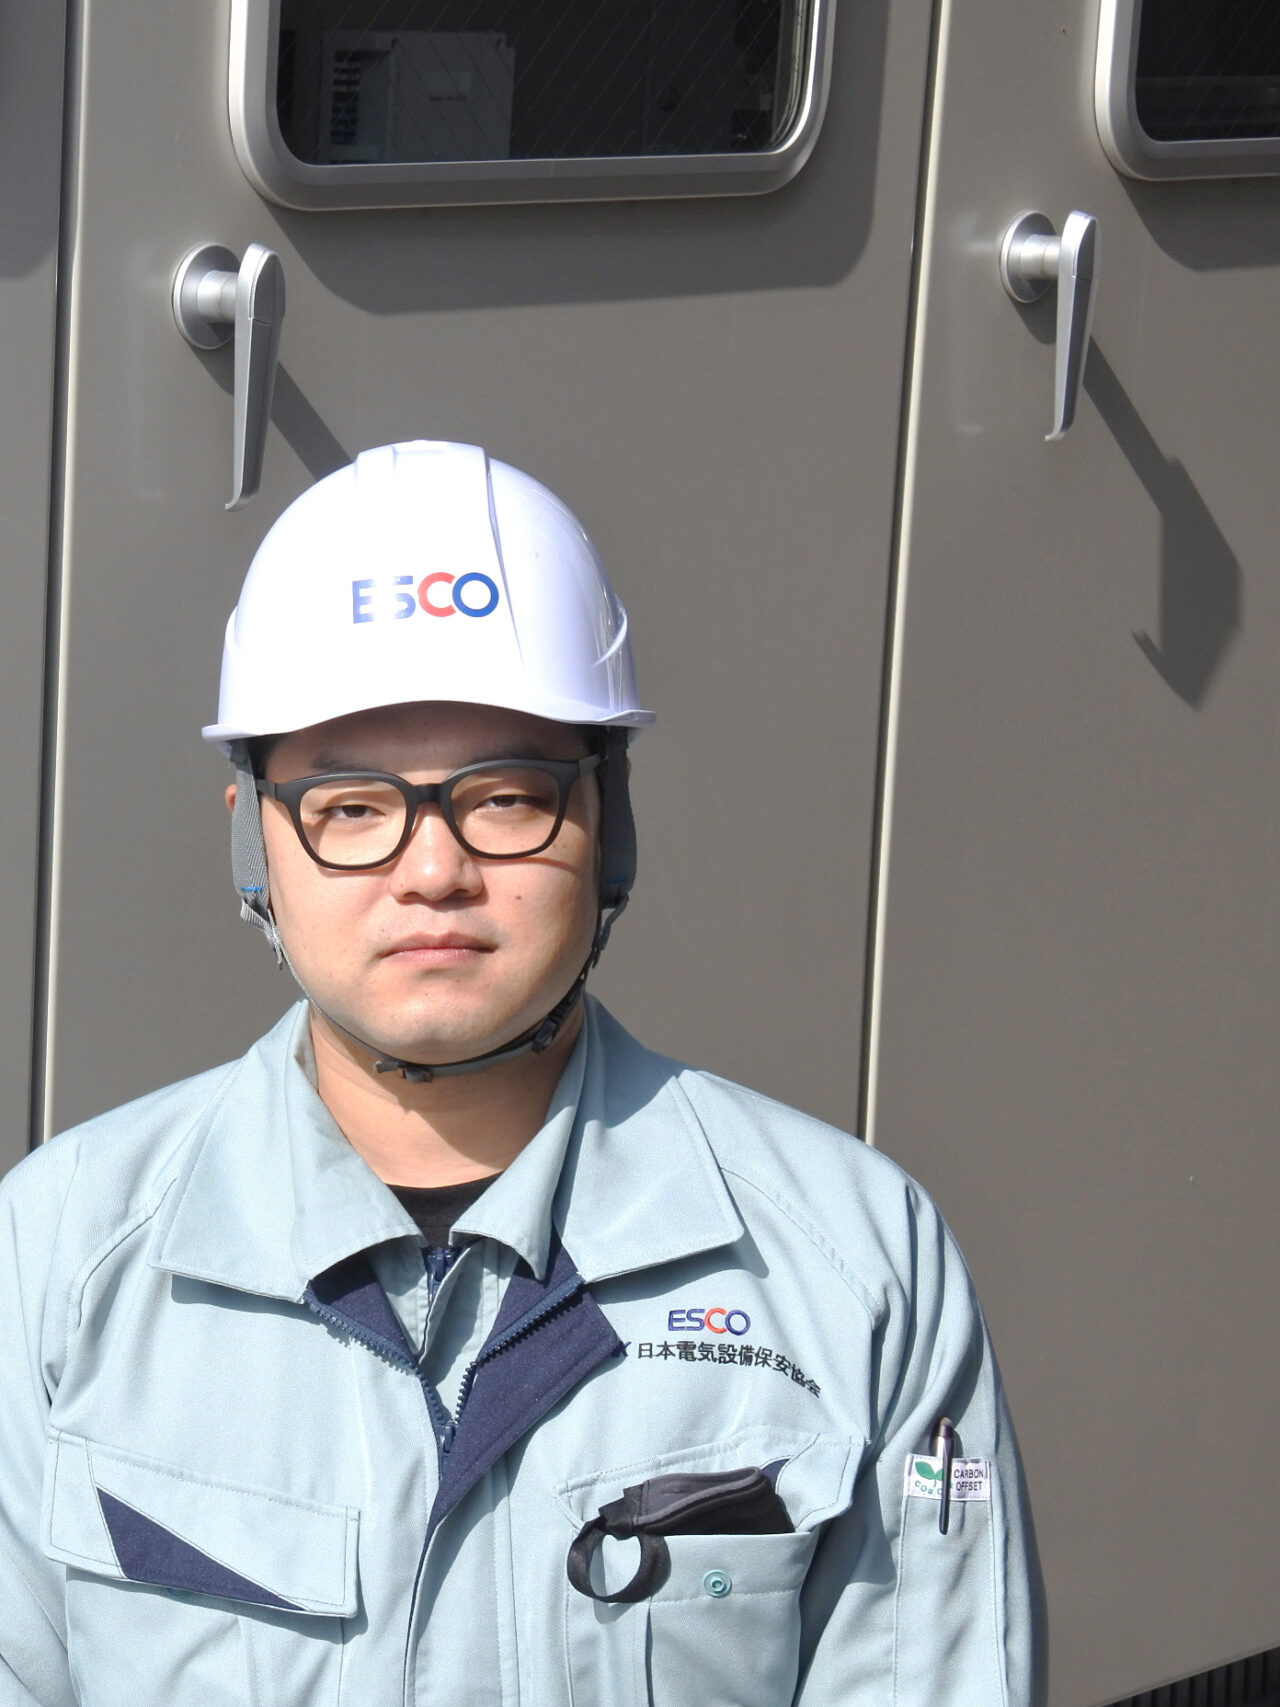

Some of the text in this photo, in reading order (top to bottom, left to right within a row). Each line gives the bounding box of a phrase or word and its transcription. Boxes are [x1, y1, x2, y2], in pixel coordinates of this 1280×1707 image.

[351, 571, 500, 625] ESCO
[667, 1307, 751, 1336] ESCO
[637, 1340, 822, 1399] 日本電気設備保安協会
[953, 1468, 984, 1479] CARBON
[955, 1481, 983, 1492] OFFSET
